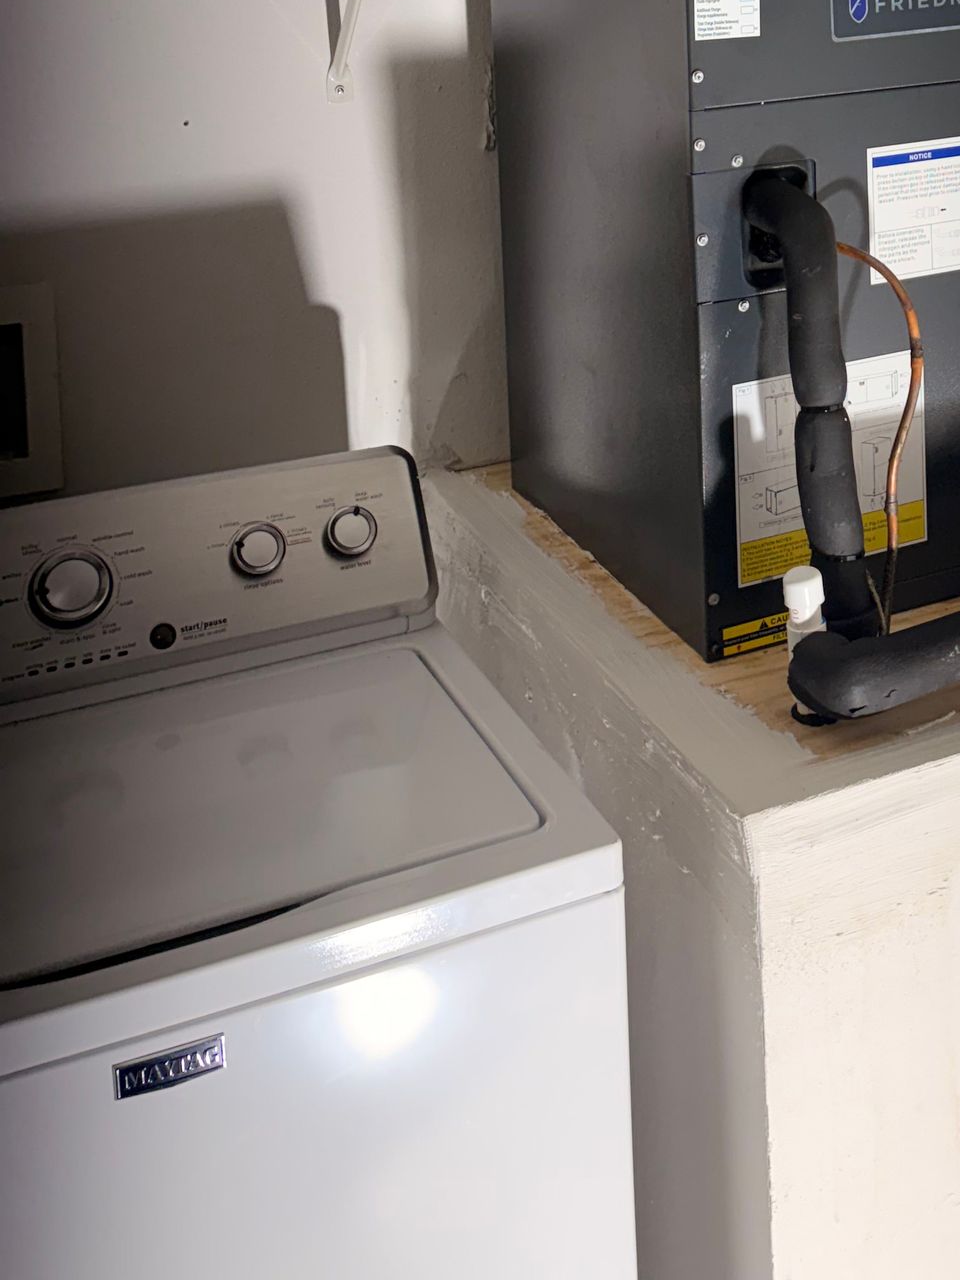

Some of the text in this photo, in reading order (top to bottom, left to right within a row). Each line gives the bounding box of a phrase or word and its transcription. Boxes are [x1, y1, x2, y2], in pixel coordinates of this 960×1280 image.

[909, 152, 932, 161] NOTICE
[180, 618, 228, 633] start/pause
[125, 1045, 219, 1090] MAYTAG
